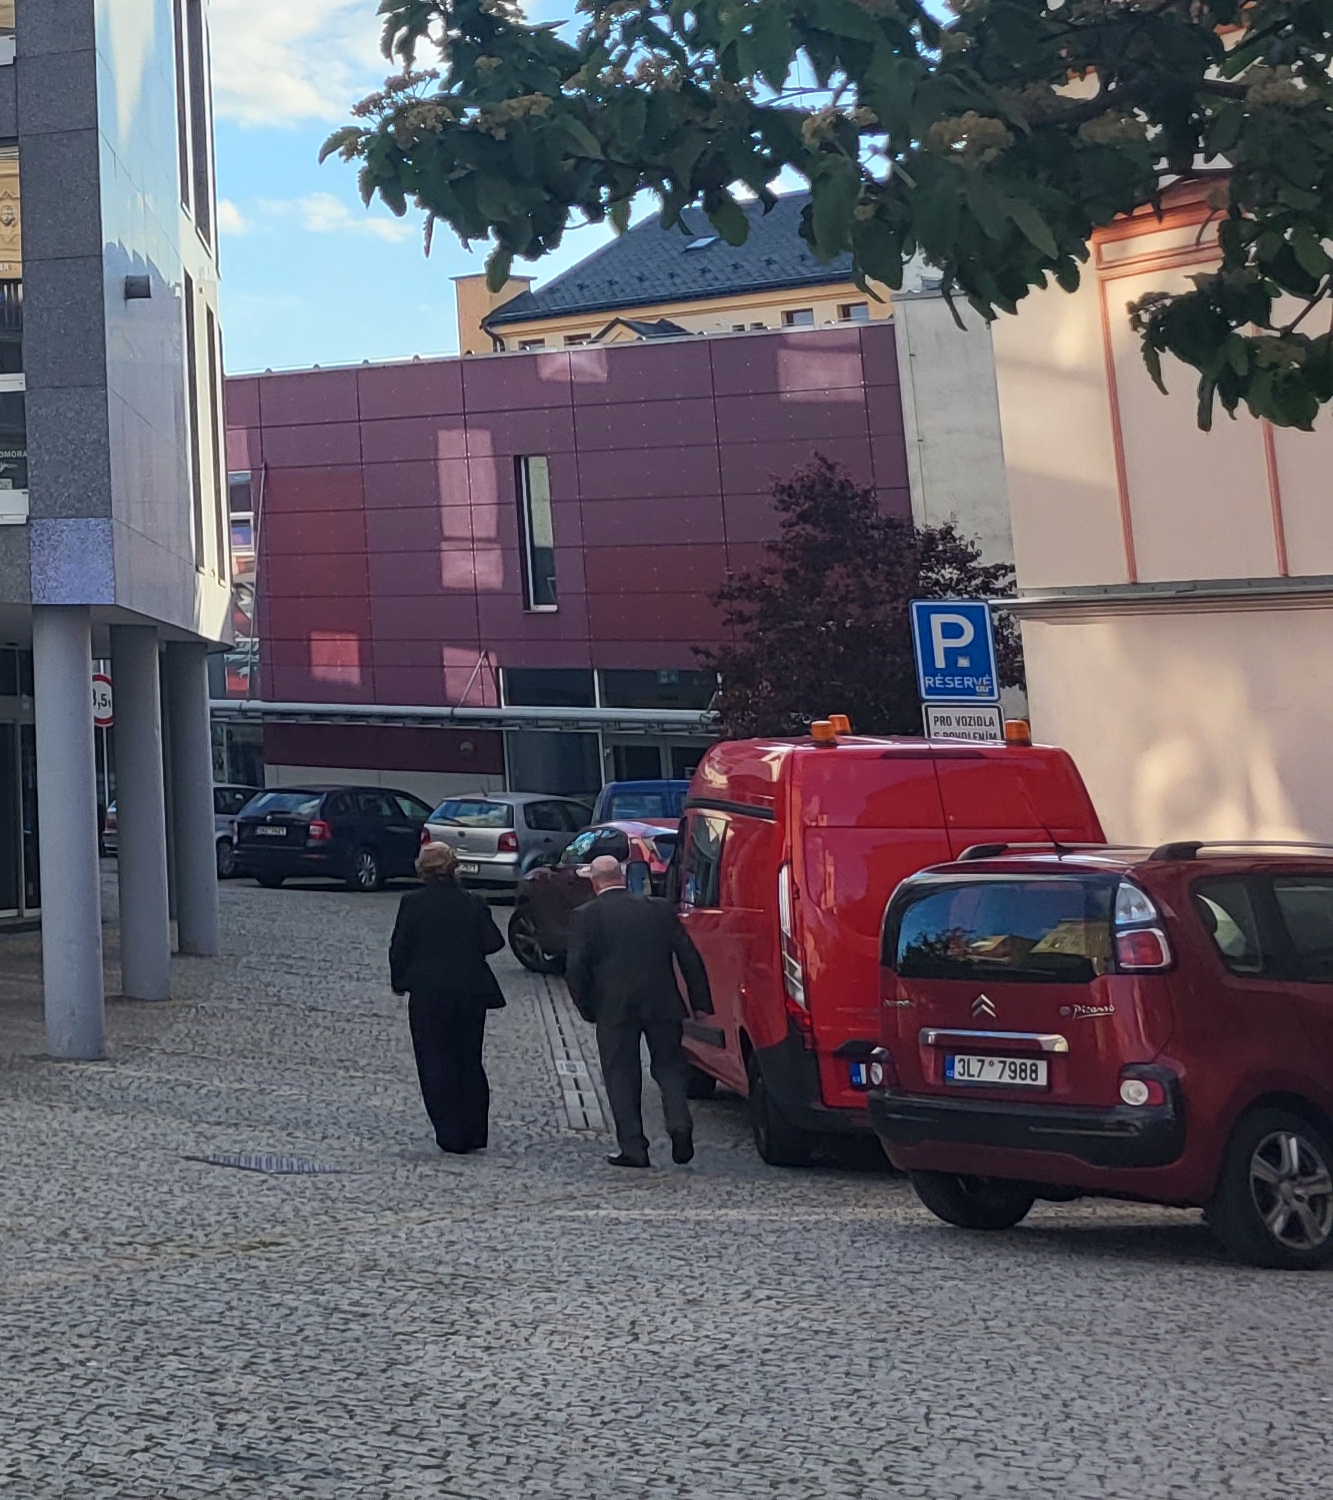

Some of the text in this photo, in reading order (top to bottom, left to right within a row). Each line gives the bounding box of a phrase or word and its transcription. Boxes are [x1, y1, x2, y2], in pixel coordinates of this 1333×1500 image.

[930, 613, 974, 669] P
[933, 715, 995, 727] PRO VOZIDLA
[958, 1057, 985, 1078] 3L7
[998, 1060, 1038, 1082] 7988
